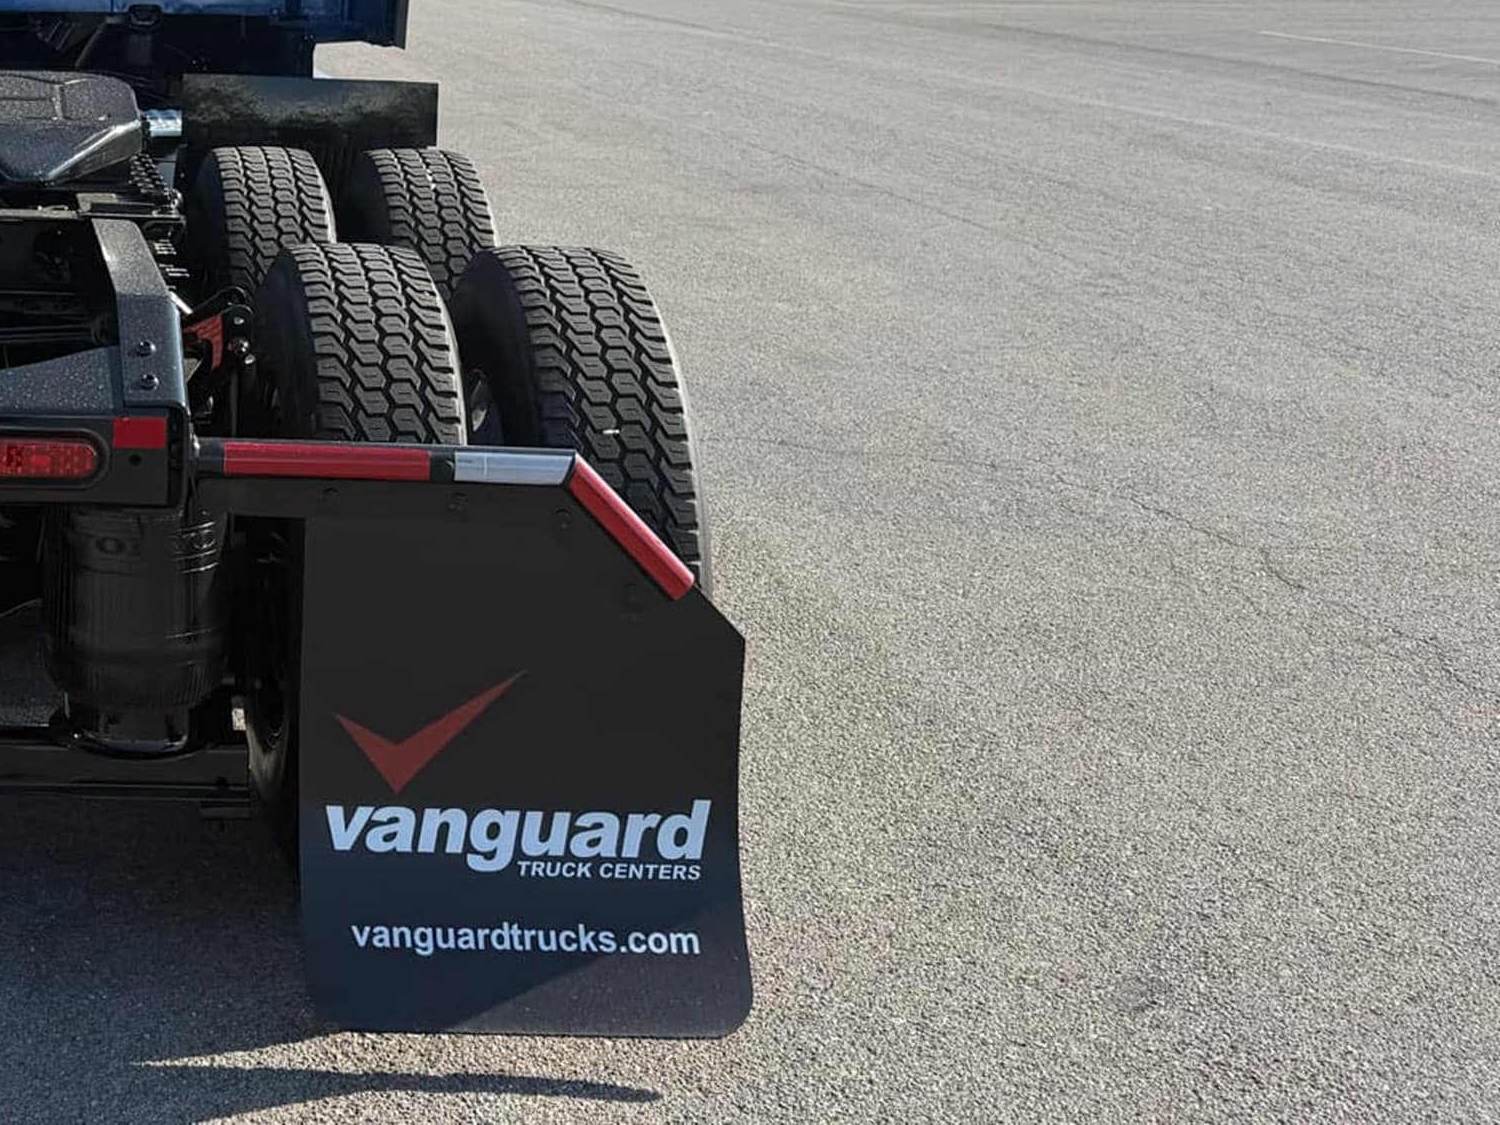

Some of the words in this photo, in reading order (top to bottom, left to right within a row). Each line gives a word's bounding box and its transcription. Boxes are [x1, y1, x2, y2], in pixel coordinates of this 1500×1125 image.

[325, 799, 712, 873] vanguard
[516, 860, 593, 879] TRUCK
[598, 862, 702, 881] CENTERS
[350, 921, 701, 957] vanguardtrucks.com
